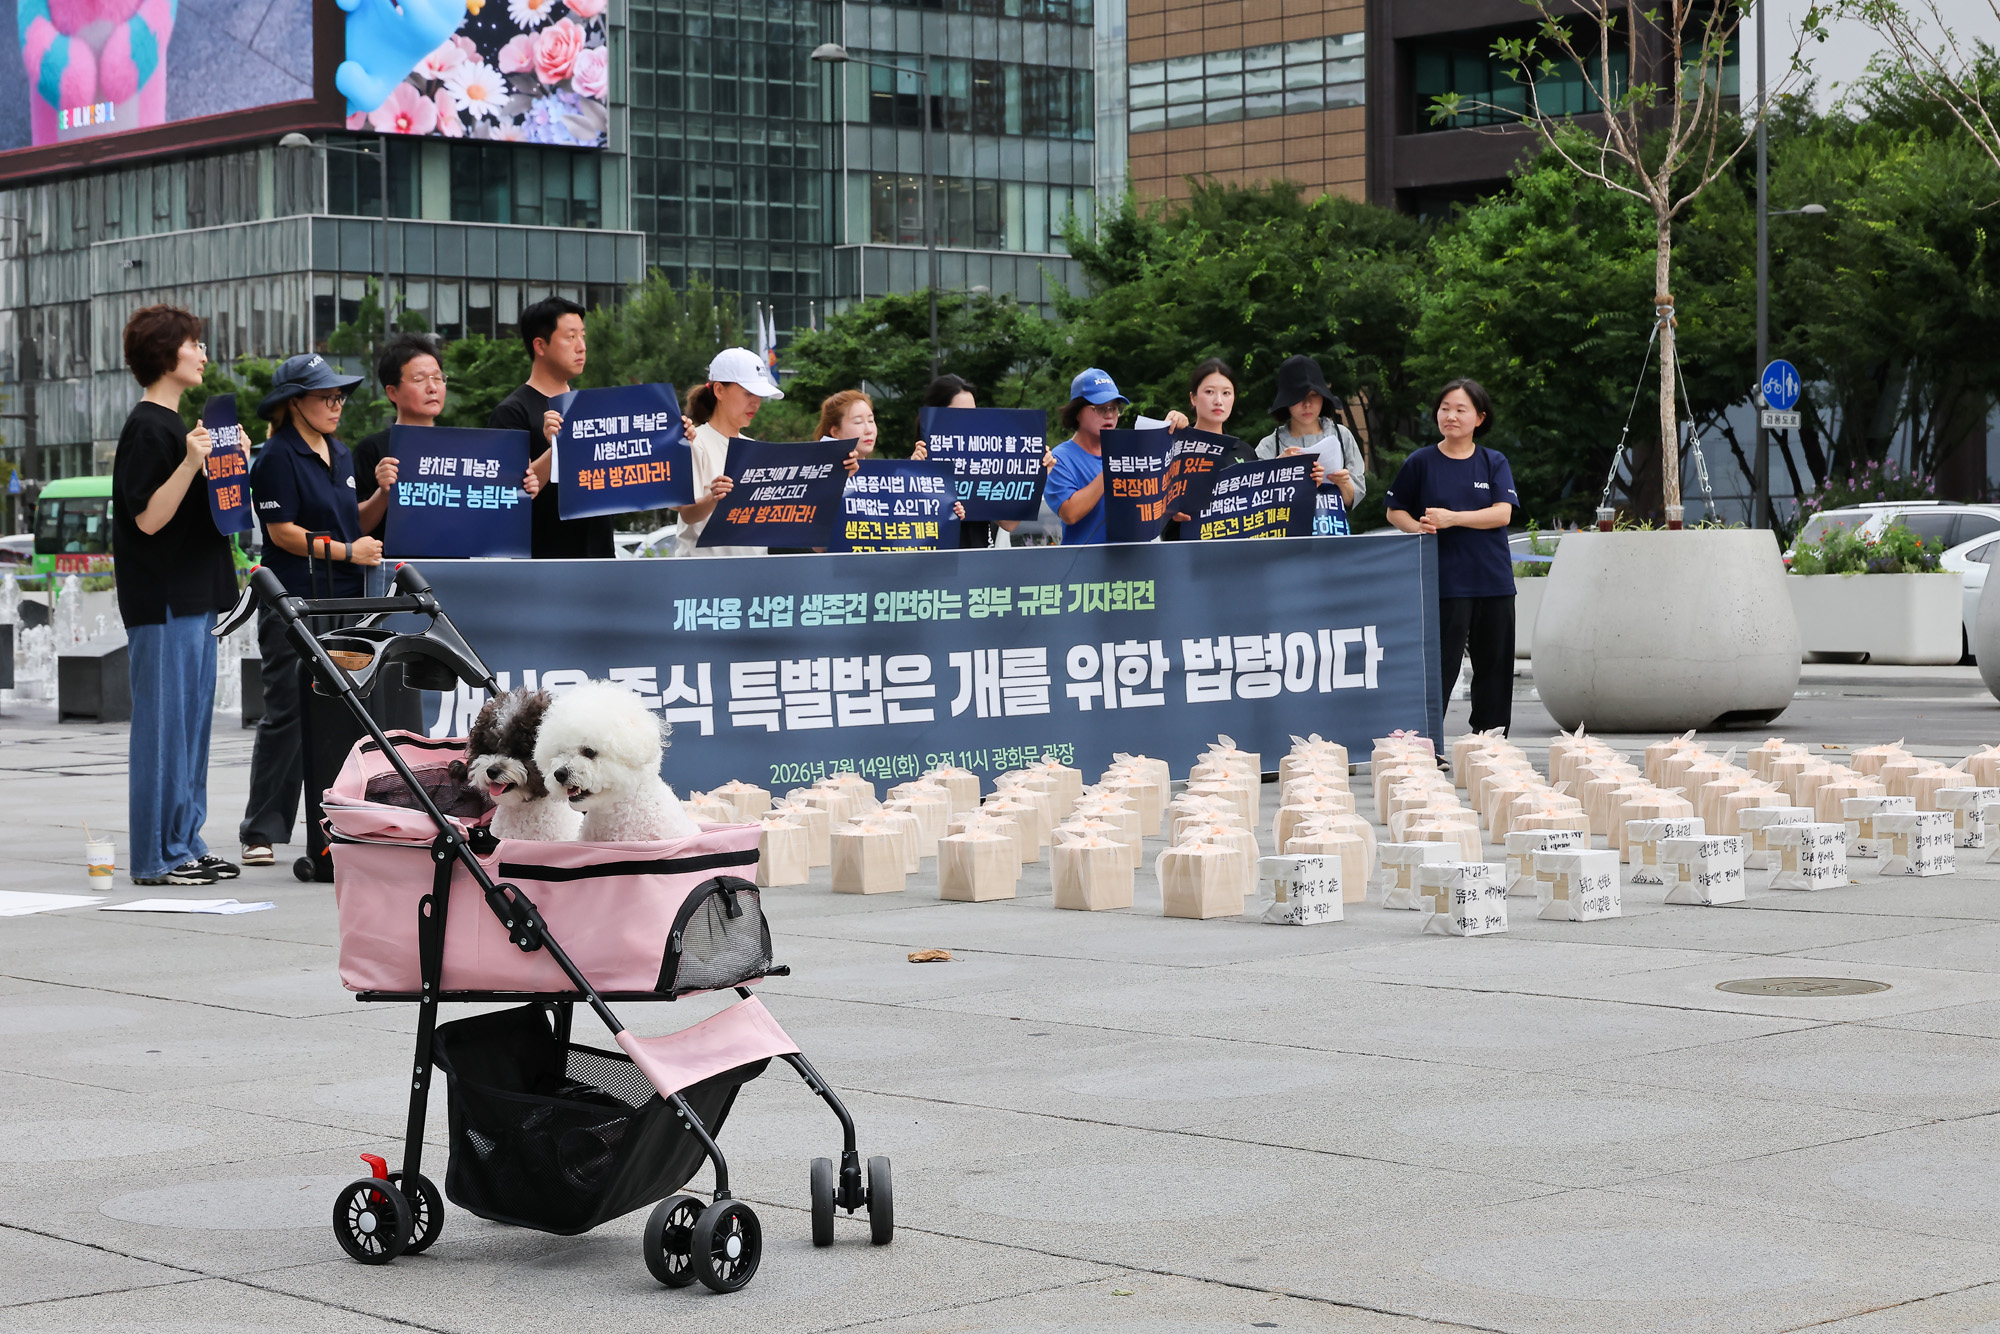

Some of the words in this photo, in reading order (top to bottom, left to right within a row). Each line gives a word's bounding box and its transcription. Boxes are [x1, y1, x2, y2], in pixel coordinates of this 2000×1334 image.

[572, 415, 630, 439] 생존견에게
[632, 412, 668, 432] 복날은
[1766, 415, 1797, 425] 겸용도로
[593, 438, 652, 461] 사형선고다
[930, 435, 965, 452] 정부가
[968, 435, 1002, 452] 세어야
[1005, 436, 1017, 453] 할
[1020, 436, 1043, 453] 것은
[418, 456, 457, 476] 방치된
[461, 458, 500, 478] 개농장
[739, 465, 799, 484] 생존견에게
[799, 463, 834, 480] 복날은
[969, 458, 1003, 475] 농장이
[1006, 458, 1041, 475] 아니라
[1108, 456, 1162, 472] 농림부는
[578, 468, 606, 491] 학살
[609, 461, 671, 488] 방조마라!
[1112, 477, 1158, 497] 현장에
[1183, 457, 1214, 474] 있는
[1267, 465, 1305, 484] 시행은
[749, 484, 808, 501] 사형선고다
[909, 476, 946, 494] 시행은
[977, 481, 1035, 501] 목숨이다
[259, 501, 281, 509] KARA
[398, 482, 462, 508] 방관하는
[466, 484, 519, 509] 농림부
[1251, 486, 1296, 508] 쇼인가?
[726, 506, 755, 524] 학살
[754, 504, 817, 524] 방조마라!
[845, 498, 889, 516] 대책없는
[893, 499, 940, 516] 쇼인가?
[845, 521, 882, 540] 생존견
[884, 521, 939, 540] 보호계획
[1200, 516, 1240, 540] 생존견
[1243, 507, 1291, 531] 보호계획
[673, 598, 742, 631] 개식용
[748, 595, 794, 629] 산업
[800, 593, 868, 627] 생존견
[872, 589, 962, 623] 외면하는
[968, 587, 1012, 619] 정부
[1017, 584, 1062, 616] 규탄
[1068, 580, 1155, 613] 기자회견
[728, 654, 936, 732] 특별법은
[949, 647, 1051, 718] 개를
[1066, 639, 1170, 711] 위한
[1182, 625, 1384, 703] 법령이다
[770, 760, 825, 784] 2026년
[859, 754, 920, 779] 14일(화)
[958, 749, 989, 771] 11시
[992, 745, 1040, 770] 광화문
